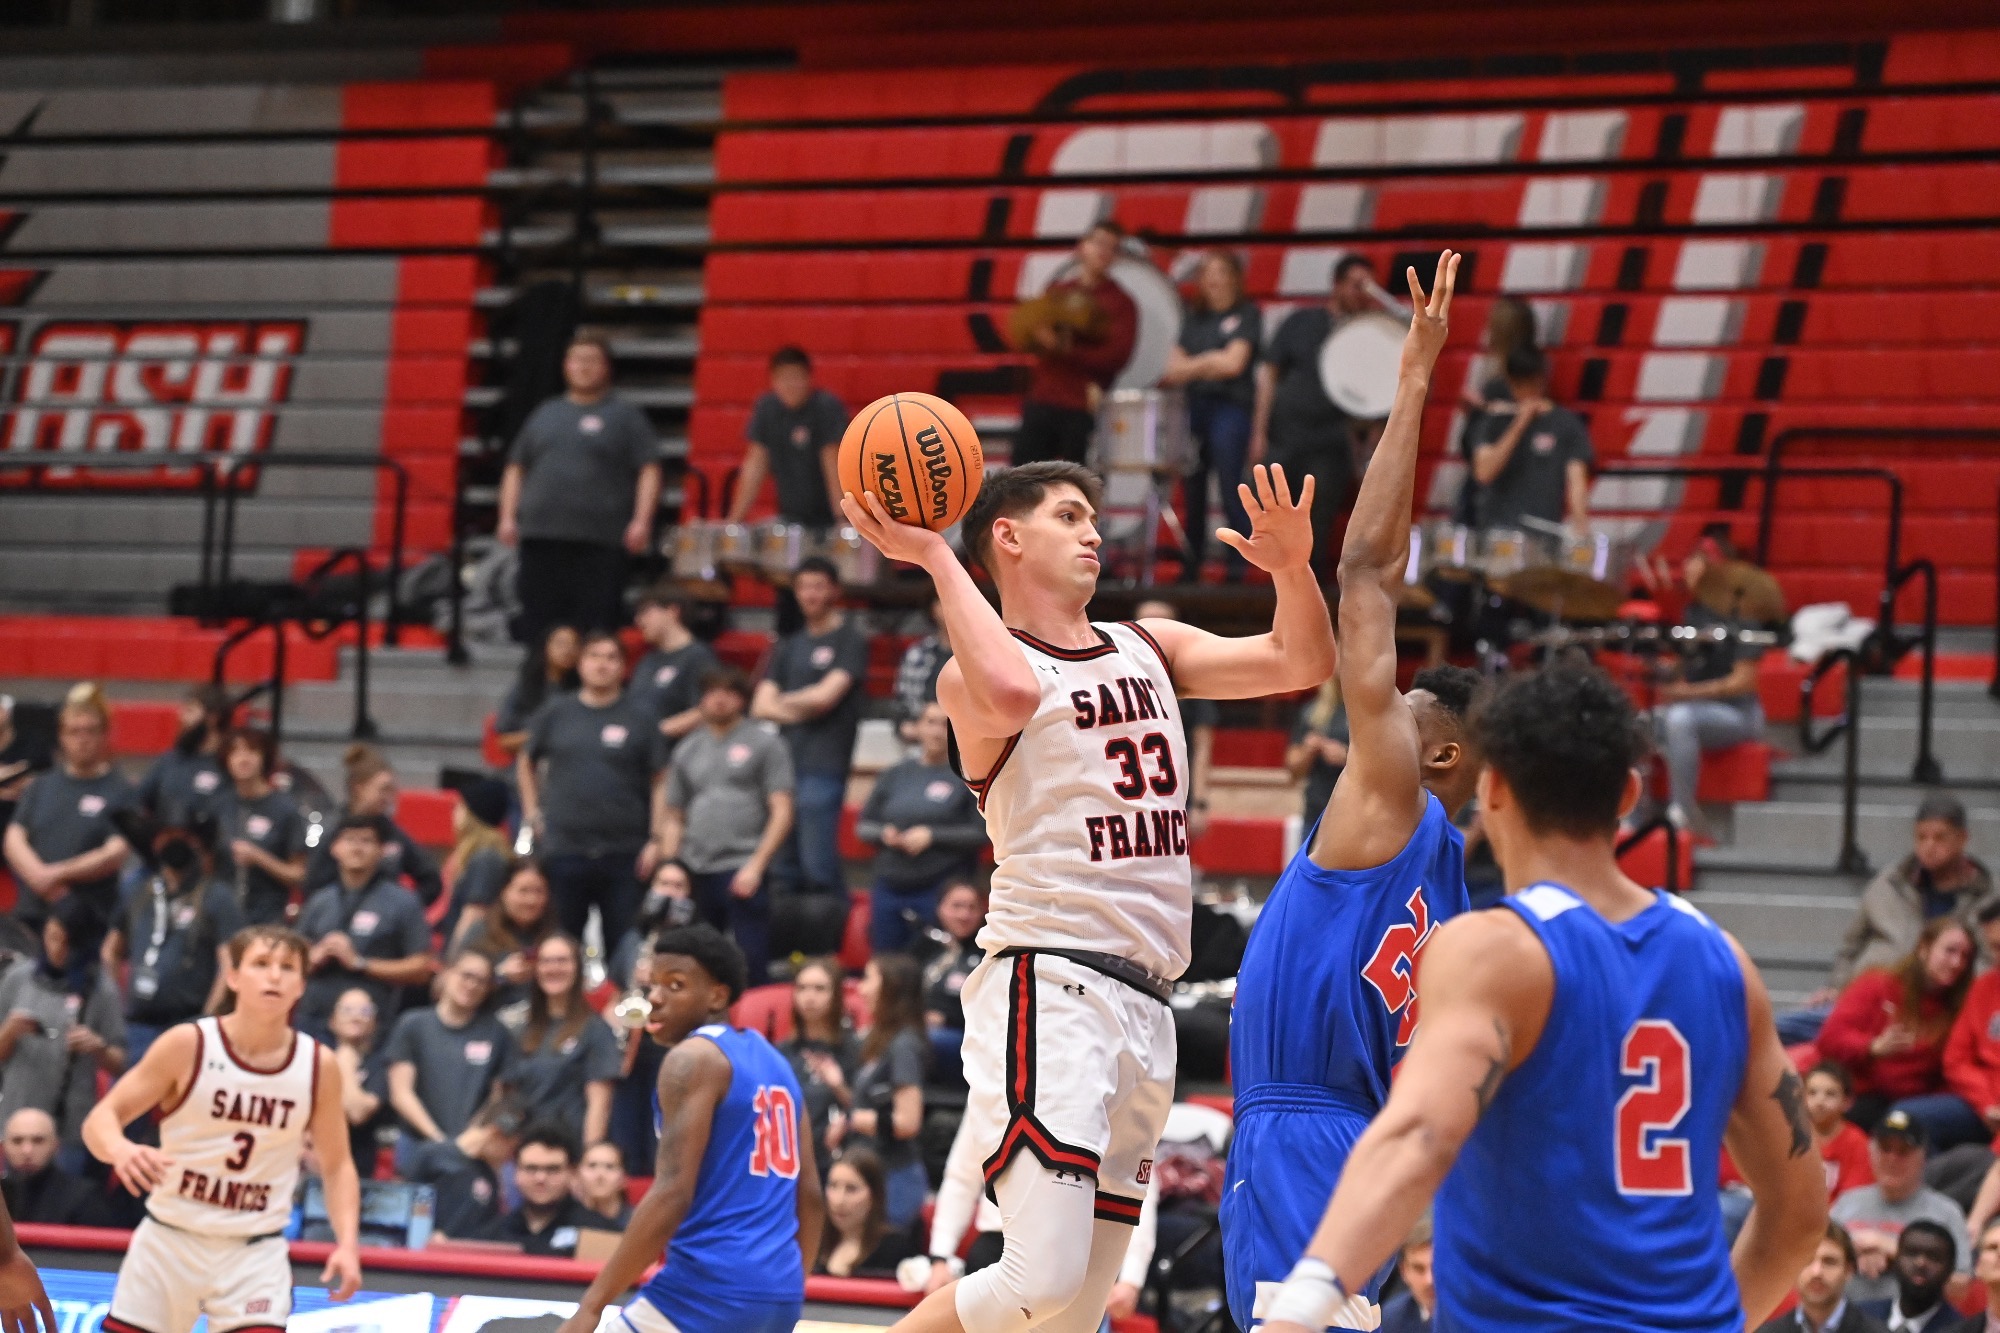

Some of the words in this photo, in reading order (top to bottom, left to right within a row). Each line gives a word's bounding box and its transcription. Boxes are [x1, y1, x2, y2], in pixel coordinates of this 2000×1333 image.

[0, 320, 306, 492] ASH
[875, 452, 909, 520] NCAA
[915, 423, 951, 521] Wilson
[1104, 731, 1178, 800] 33
[211, 1088, 296, 1129] SAINT
[748, 1084, 800, 1180] 10
[1613, 1018, 1694, 1197] 2
[225, 1131, 256, 1171] 3
[178, 1169, 272, 1212] FRANCIS
